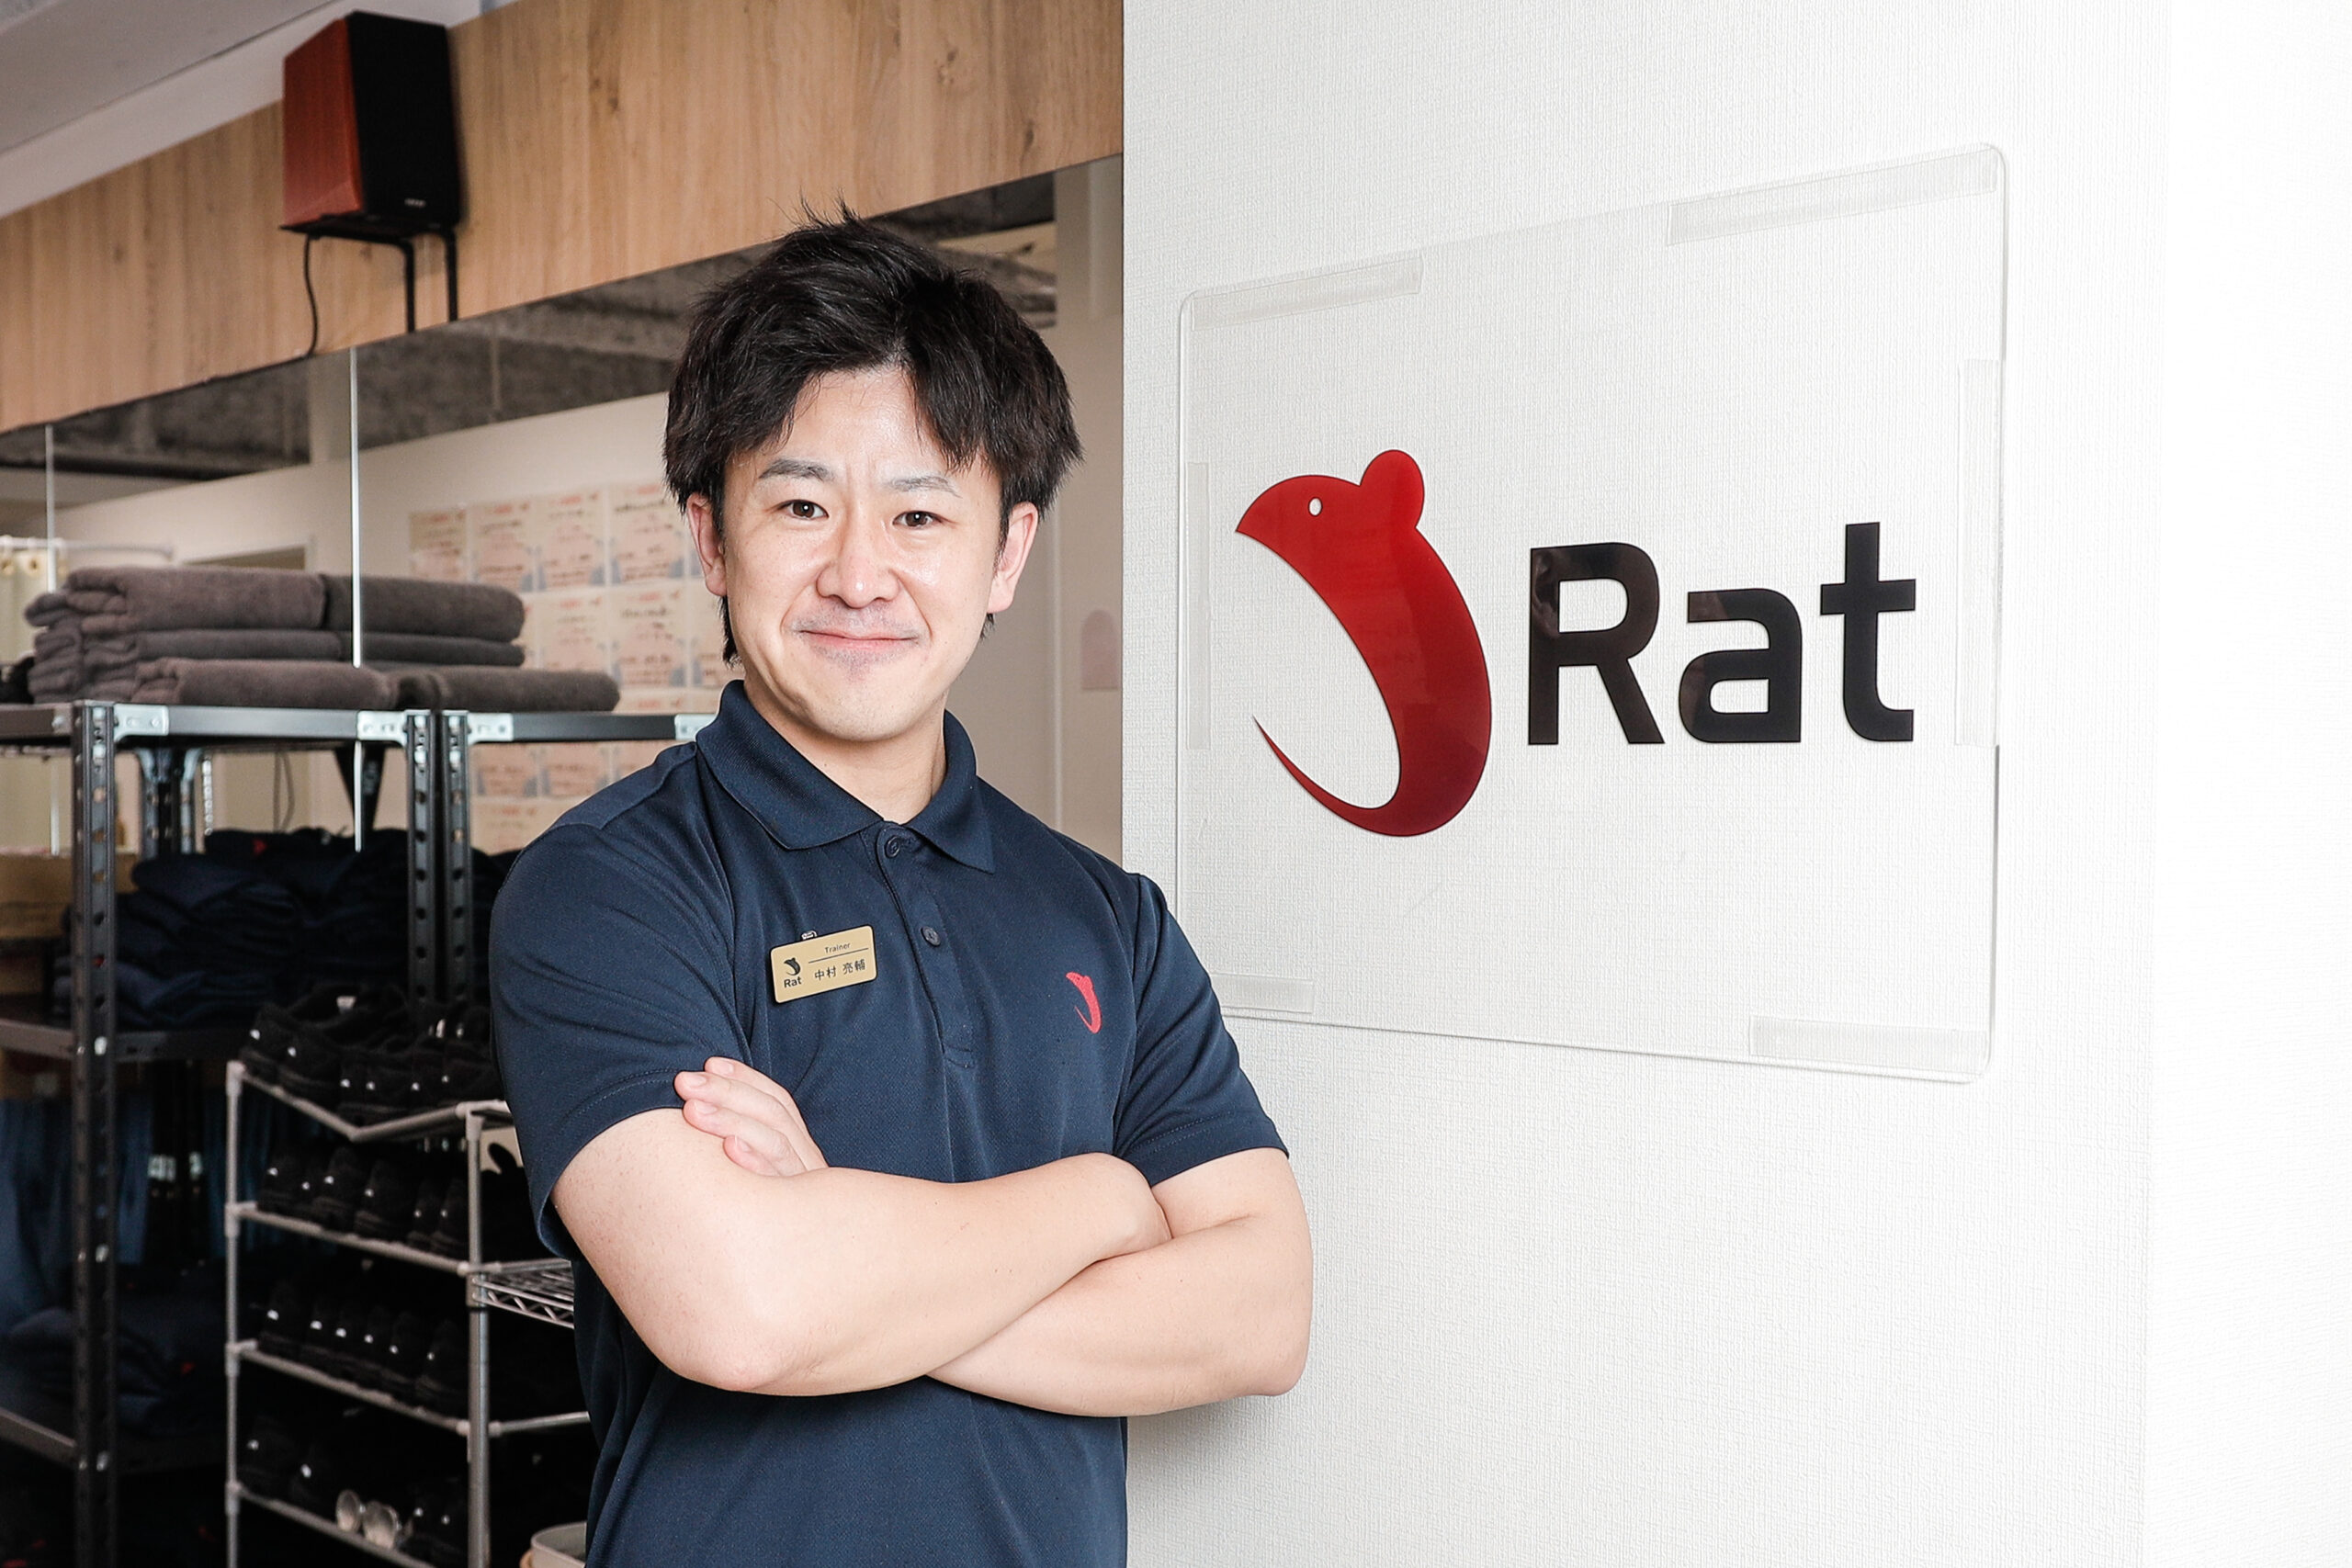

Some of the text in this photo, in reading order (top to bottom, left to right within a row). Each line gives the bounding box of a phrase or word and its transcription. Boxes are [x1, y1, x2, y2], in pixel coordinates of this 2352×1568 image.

[1528, 522, 1917, 745] Rat
[825, 942, 851, 953] Trainer
[814, 964, 837, 981] 中村
[784, 976, 802, 988] Rat
